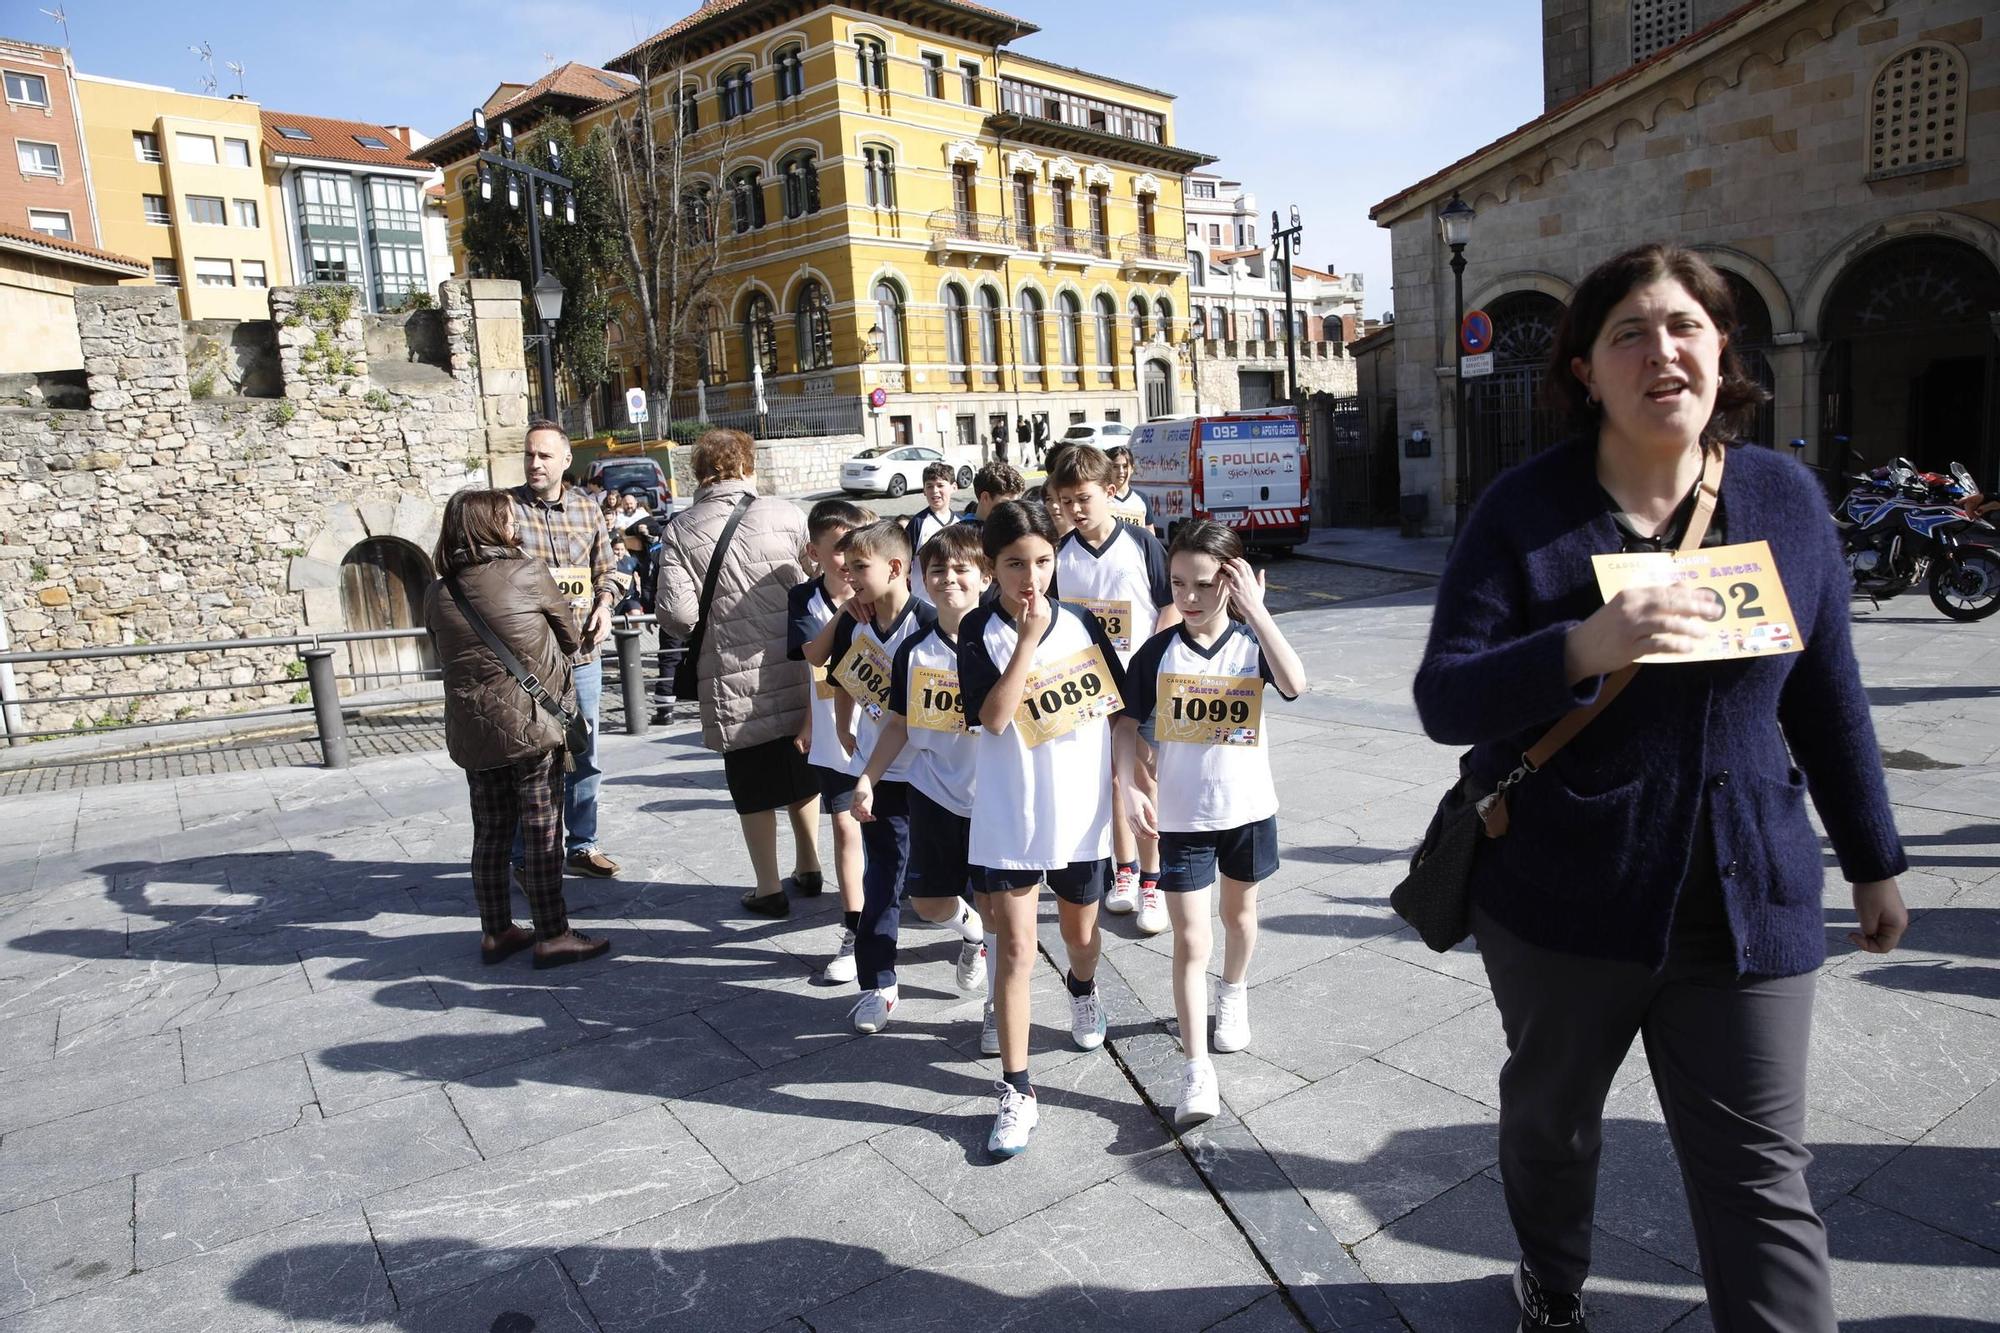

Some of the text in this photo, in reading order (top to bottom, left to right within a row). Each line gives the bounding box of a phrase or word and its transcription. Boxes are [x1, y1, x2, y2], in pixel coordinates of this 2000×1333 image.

[1212, 425, 1239, 439] 092
[1166, 490, 1183, 514] 092
[849, 653, 892, 703] 1084
[1187, 686, 1220, 695] SANTO
[1023, 672, 1102, 721] 1089
[1171, 697, 1249, 723] 1099
